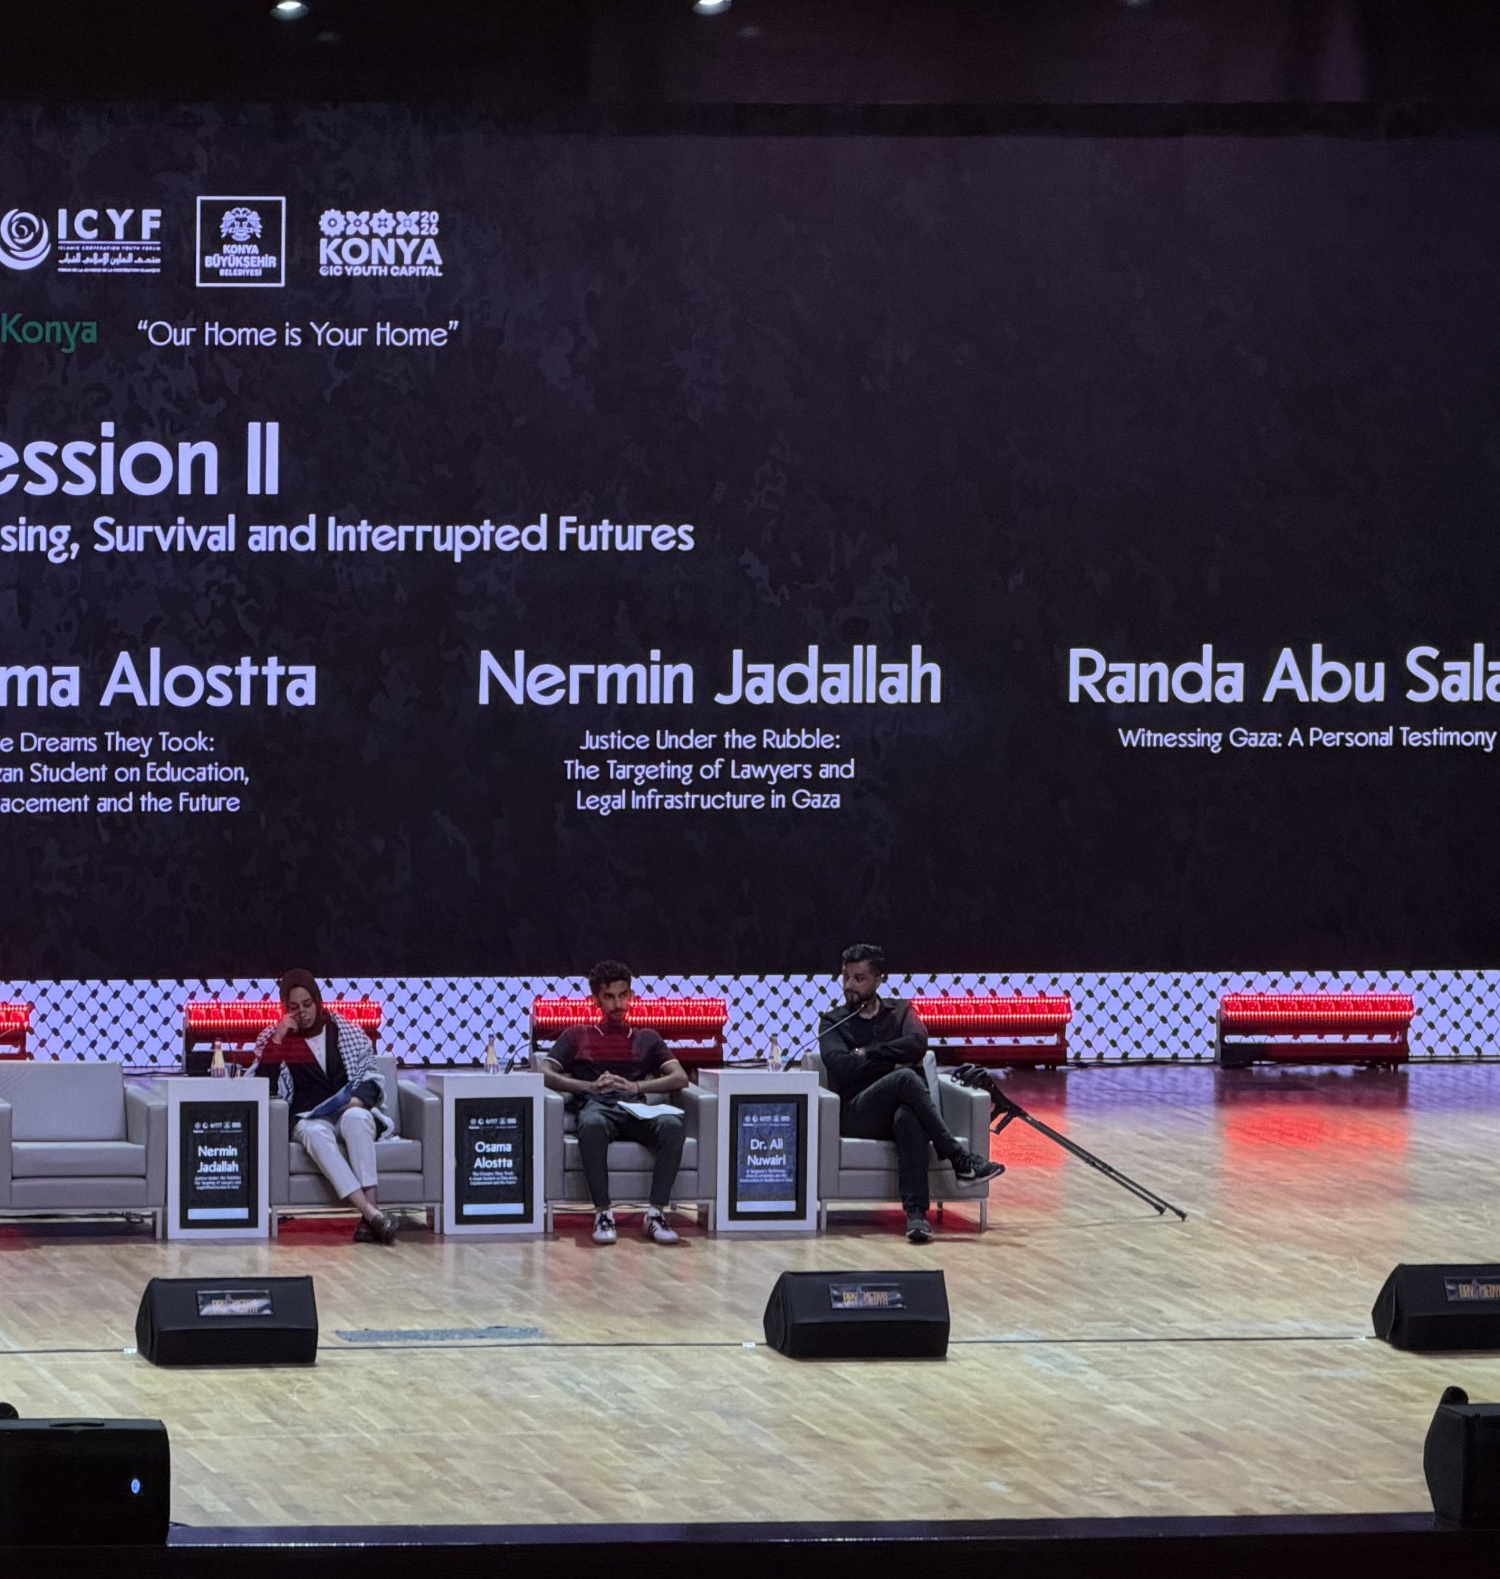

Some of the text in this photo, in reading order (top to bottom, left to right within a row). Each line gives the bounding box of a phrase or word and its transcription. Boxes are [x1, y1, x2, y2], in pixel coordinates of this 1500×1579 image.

[57, 208, 162, 240] ICYF
[420, 211, 439, 223] 20
[420, 223, 439, 236] 26
[222, 244, 259, 255] KONYA
[319, 238, 443, 265] KONYA
[345, 266, 388, 277] YOUTH
[390, 266, 443, 277] CAPITAL
[1, 312, 97, 354] Konya
[137, 319, 460, 347] “Our Home is Your Home”
[246, 421, 280, 496] II
[92, 513, 236, 553] Survival
[247, 513, 317, 553] and
[327, 513, 548, 563] Interrupted
[558, 515, 695, 552] Futures
[99, 646, 317, 708] Alostta
[478, 644, 942, 706] Nermin Jadallah
[1068, 643, 1245, 704] Randa
[1262, 643, 1386, 703] Abu
[19, 731, 98, 753] Dreams
[103, 730, 154, 759] They
[158, 729, 215, 753] Took:
[579, 727, 841, 751] Justice Under the Rubble:
[1117, 725, 1498, 754] Witnessing Gaza: A Personal Testimony
[29, 760, 109, 784] Student
[114, 766, 141, 783] on
[146, 760, 250, 786] Education,
[563, 757, 855, 785] The Targeting of Lawyers and
[96, 791, 134, 814] and
[139, 791, 173, 813] the
[178, 791, 241, 813] Future
[576, 787, 841, 817] Legal Infrastructure in Gaza
[198, 1144, 238, 1157] Nermin
[475, 1141, 512, 1153] Osama
[750, 1138, 783, 1150] Dr. Ali
[197, 1160, 239, 1173] Jadallah
[474, 1156, 512, 1169] Alostta
[747, 1154, 786, 1166] Nuwairi
